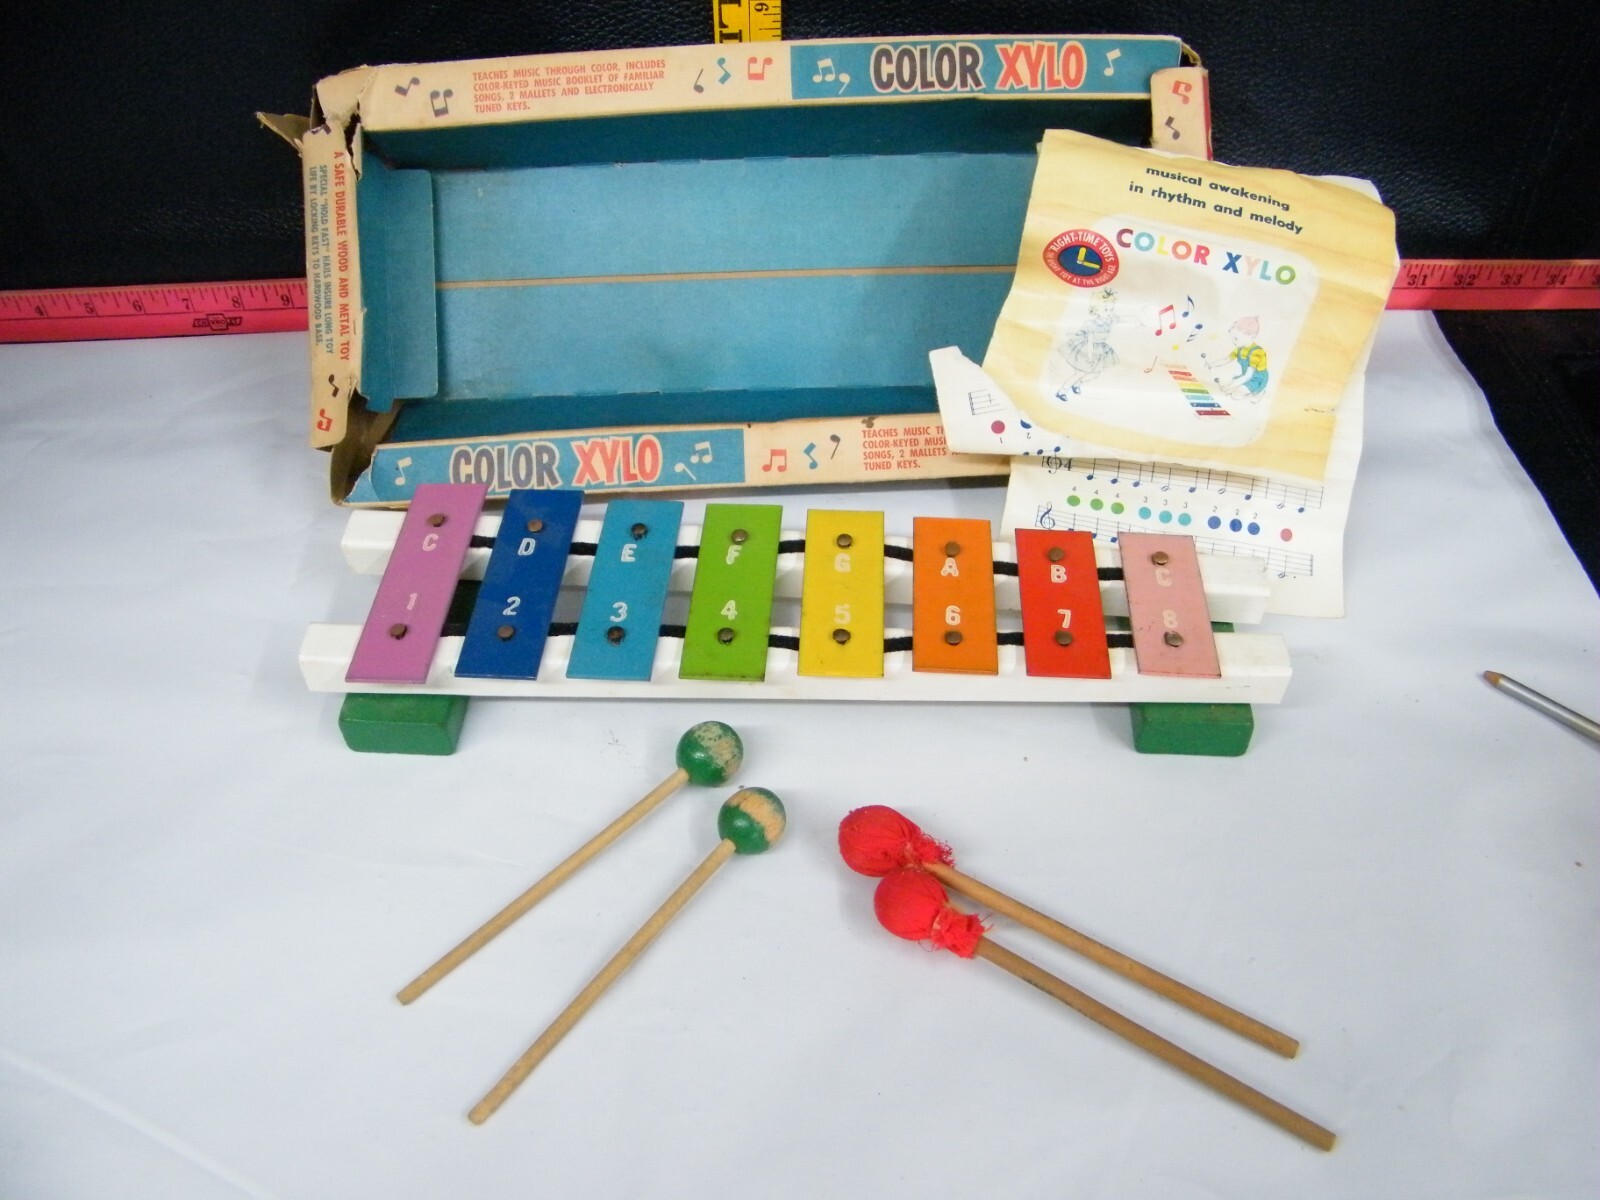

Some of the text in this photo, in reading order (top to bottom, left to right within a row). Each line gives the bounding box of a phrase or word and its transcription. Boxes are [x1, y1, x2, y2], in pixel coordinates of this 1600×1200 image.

[473, 59, 666, 81] TEACHES MUSIC THROUGH COLOR, INCLUDES
[871, 40, 1087, 92] COLOR XYLO
[473, 70, 665, 92] COLOR-KEYED MUSIC BOOKLET OF FAMILIAR
[473, 92, 505, 103] SONGS,
[519, 88, 556, 99] MALLETS
[561, 86, 580, 96] AND
[584, 80, 654, 94] ELECTRONICALLY
[474, 101, 531, 113] TUNED KEYS.
[309, 166, 317, 181] LIFE
[320, 164, 328, 197] SPECIAL
[309, 185, 317, 195] BY
[1145, 167, 1290, 212] musical awakening
[310, 198, 318, 233] LOCKING
[1128, 181, 1303, 235] in rhythm and melody
[311, 235, 319, 256] KEYS
[1098, 242, 1115, 262] TOYS
[312, 259, 320, 270] TO
[334, 151, 350, 361] A SAFE DURABLE WOOD AND METAL TOY
[1116, 228, 1297, 286] COLOR XYLO
[1454, 274, 1477, 286] 32
[182, 298, 190, 310] 7
[232, 296, 241, 308] 8
[280, 293, 291, 307] 9
[313, 272, 322, 320] HARDWOOD
[323, 281, 332, 310] INSURE
[84, 302, 94, 314] 5
[132, 299, 143, 312] 6
[324, 312, 333, 335] LONG
[325, 337, 334, 354] TOY
[862, 428, 898, 438] TEACHES
[904, 426, 930, 436] MUSIC
[863, 437, 946, 449] COLOR-KEYED MUSI
[450, 434, 662, 490] COLOR XYLO
[863, 447, 946, 460] SONGS, 2 MALLETS
[863, 460, 920, 470] TUNED KEYS.
[422, 534, 439, 552] C
[518, 537, 535, 556] D
[621, 544, 637, 562] E
[725, 545, 742, 565] F
[834, 554, 851, 573] G
[940, 558, 959, 577] A
[1050, 565, 1067, 583] B
[1155, 568, 1172, 587] C
[406, 593, 418, 610] 1
[502, 596, 521, 616] 2
[721, 600, 737, 620] 4
[610, 602, 628, 622] 3
[835, 604, 851, 624] 5
[945, 606, 961, 625] 6
[1057, 609, 1072, 628] 7
[1162, 610, 1177, 628] 8
